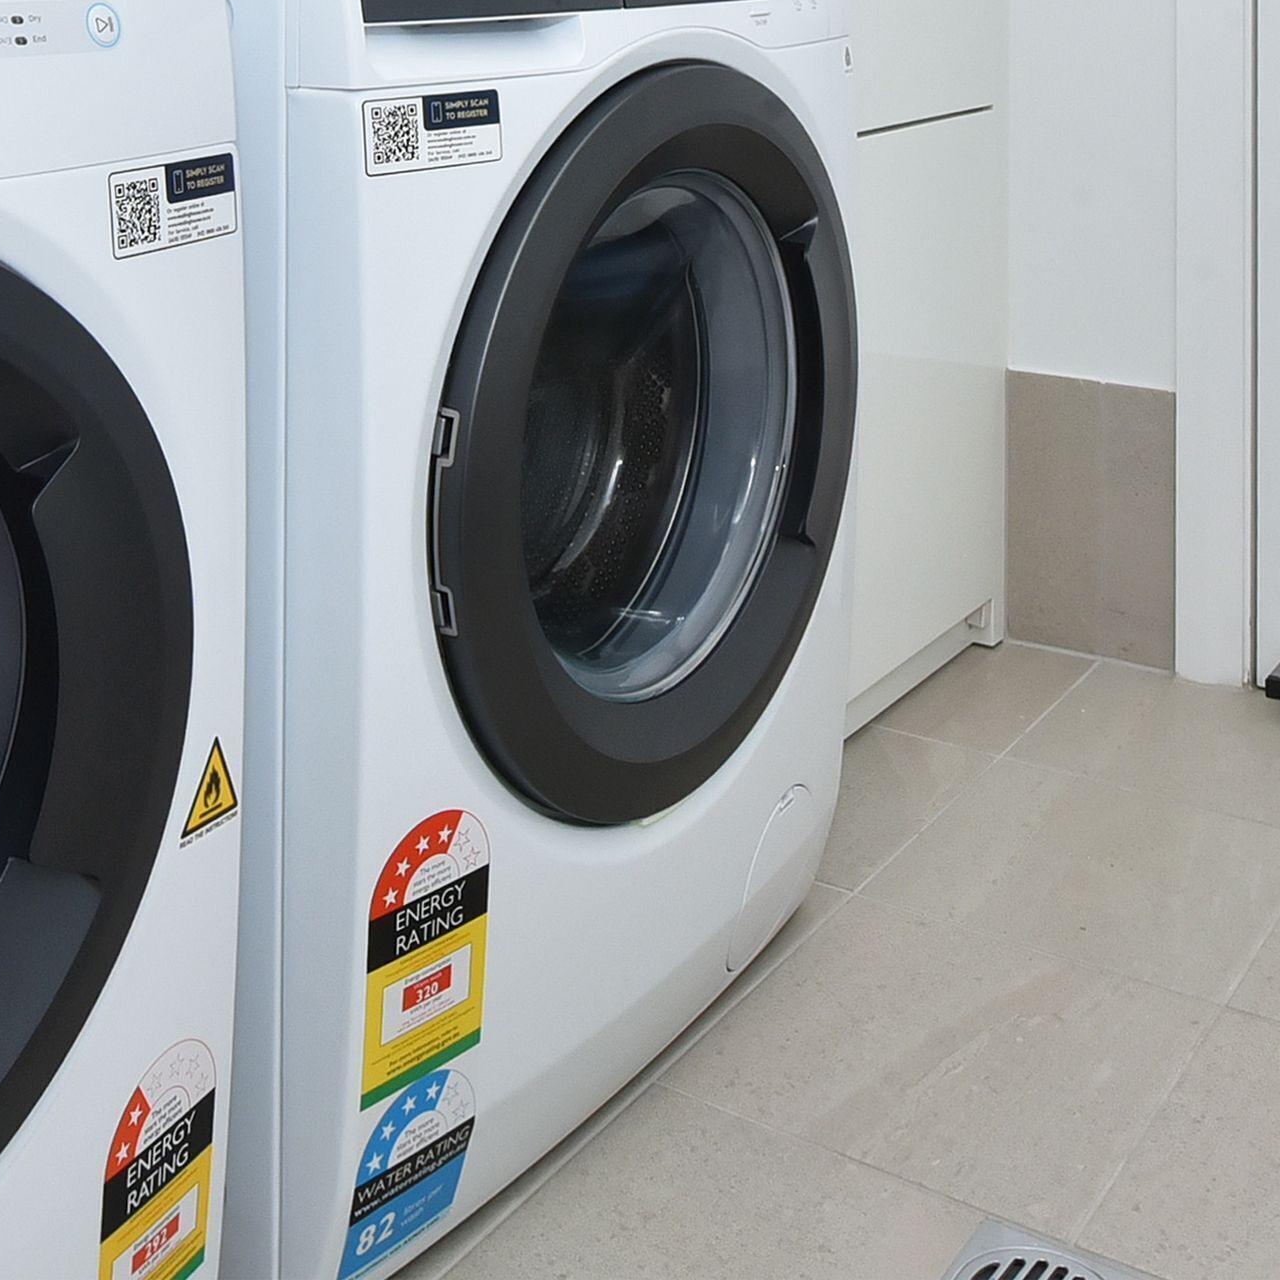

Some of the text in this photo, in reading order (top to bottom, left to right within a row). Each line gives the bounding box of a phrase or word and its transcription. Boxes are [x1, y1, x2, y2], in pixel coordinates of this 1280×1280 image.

[445, 98, 489, 110] SIMPLY SCAN
[446, 108, 488, 120] TO REGISTER
[185, 164, 226, 178] SIMPLY SCAN
[186, 176, 225, 190] TO REGISTER
[395, 881, 466, 931] ENERGY
[395, 905, 464, 955] RATING
[415, 981, 439, 1004] 320
[126, 1110, 196, 1188] ENERGY
[358, 1125, 470, 1203] WATER RATING
[126, 1142, 189, 1214] RATING
[144, 1227, 168, 1261] 292
[355, 1211, 396, 1257] 82
